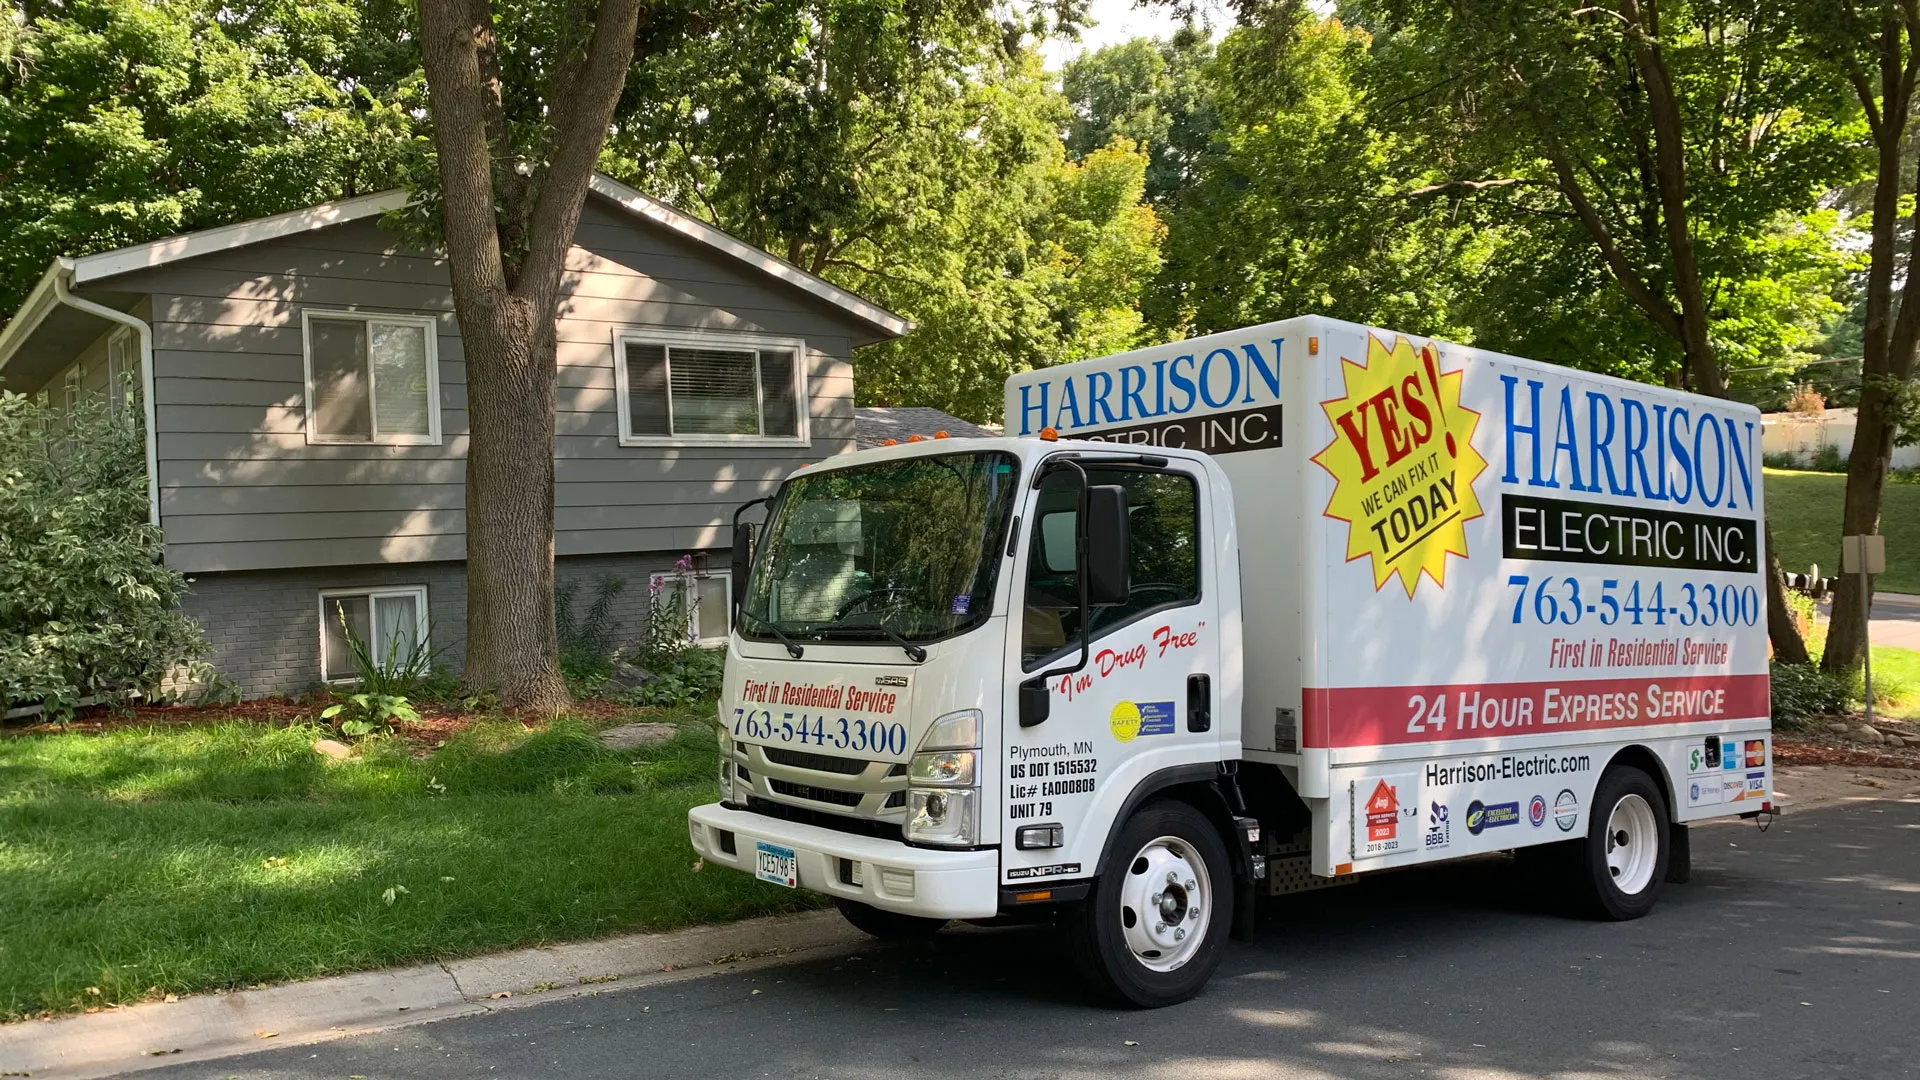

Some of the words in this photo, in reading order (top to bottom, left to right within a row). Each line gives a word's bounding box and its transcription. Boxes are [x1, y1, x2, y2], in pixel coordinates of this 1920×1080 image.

[1019, 338, 1284, 435] HARRISON
[1201, 413, 1278, 448] INC.
[1336, 346, 1457, 485] YES!
[1500, 375, 1754, 511] HARRISON
[1361, 491, 1383, 518] WE
[1383, 474, 1407, 504] CAN
[1407, 460, 1428, 487] FIX
[1428, 452, 1440, 475] IT
[1370, 470, 1458, 554] TODAY
[1514, 507, 1685, 560] ELECTRIC
[1694, 524, 1751, 564] INC.
[1507, 575, 1759, 627] 763-544-3300
[1095, 644, 1148, 678] Drug
[1549, 638, 1587, 668] First
[1589, 638, 1603, 667] in
[1607, 638, 1680, 667] Residential
[1682, 637, 1728, 665] Service
[743, 680, 768, 702] First
[768, 681, 780, 704] in
[781, 682, 844, 709] Residential
[845, 685, 897, 714] Service
[1406, 694, 1447, 733] 24
[733, 708, 907, 756] 763-544-3300
[1010, 743, 1070, 761] Plymouth,
[1073, 741, 1093, 754] MN
[1010, 764, 1026, 778] US
[1029, 762, 1050, 777] DOT
[1053, 759, 1097, 775] 1515532
[1426, 754, 1590, 787] Harrison-Electric.com
[1749, 779, 1763, 790] VISA
[1010, 784, 1038, 799] Lic#
[1042, 778, 1096, 796] EA000808
[1010, 803, 1036, 819] UNIT
[1039, 802, 1052, 816] 79
[1487, 808, 1512, 817] EXCELLENT
[1426, 833, 1444, 846] BBB
[758, 851, 789, 877] YCE5798
